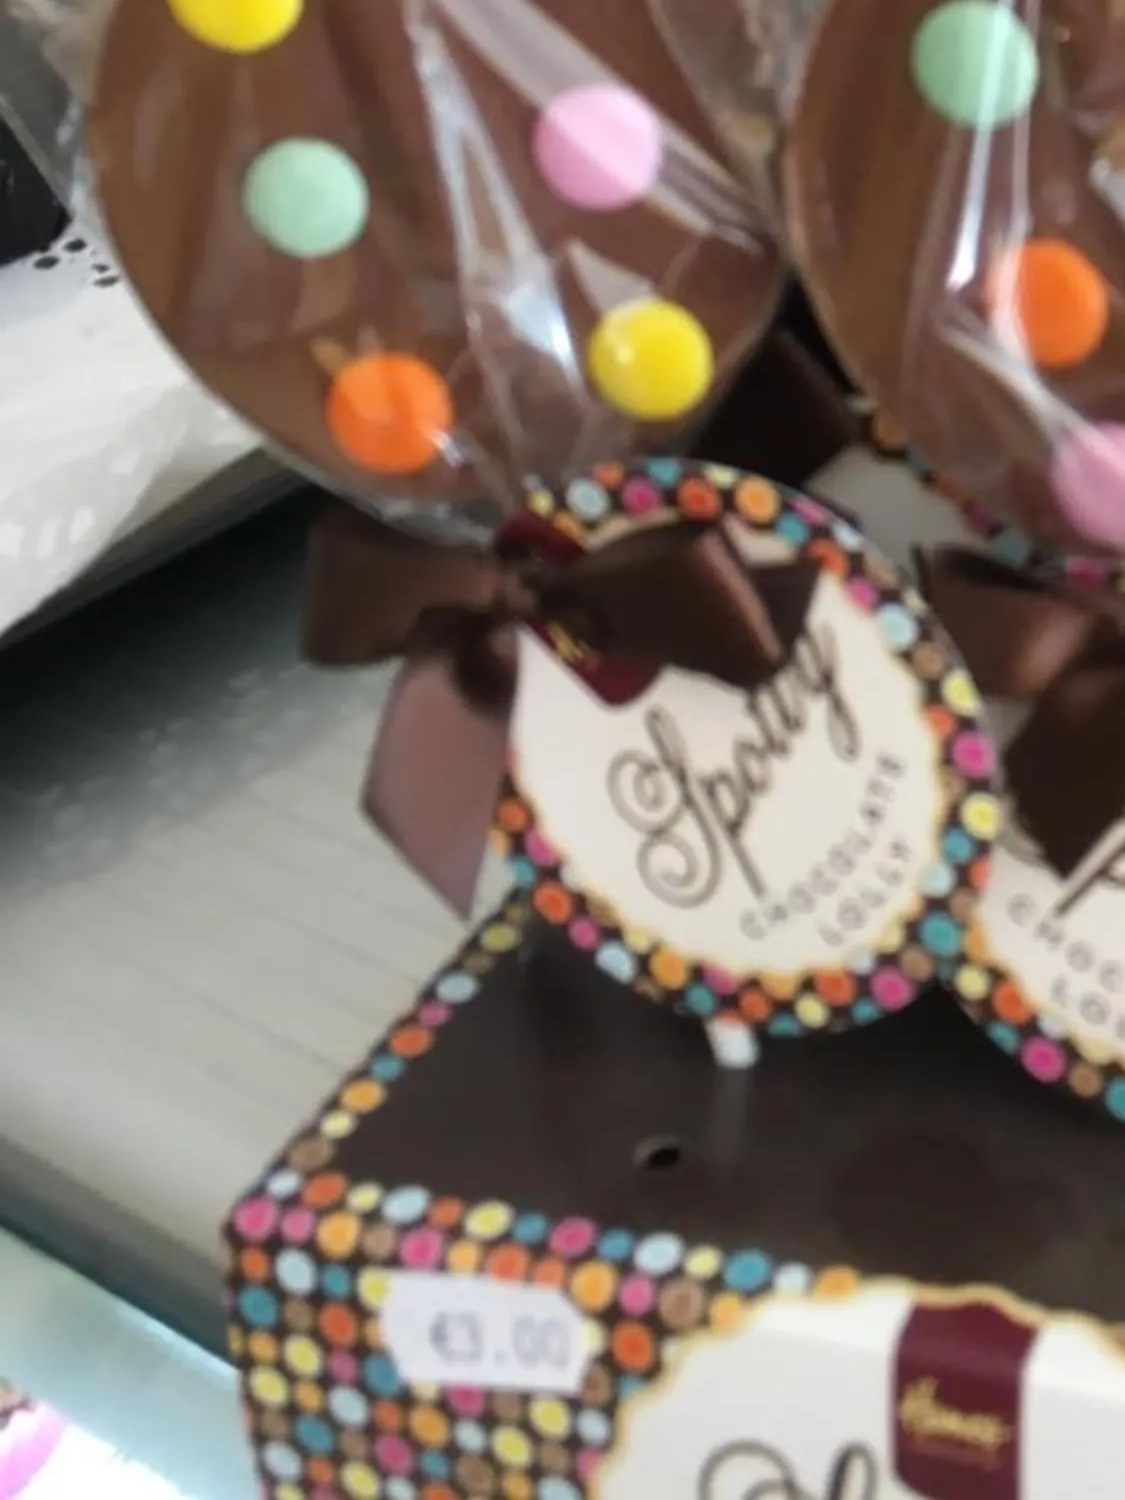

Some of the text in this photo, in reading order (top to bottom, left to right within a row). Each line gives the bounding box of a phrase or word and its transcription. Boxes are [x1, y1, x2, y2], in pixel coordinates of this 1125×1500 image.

[606, 621, 858, 909] Spotty
[738, 750, 906, 942] CHOCOLATE
[817, 837, 913, 948] LOLLY
